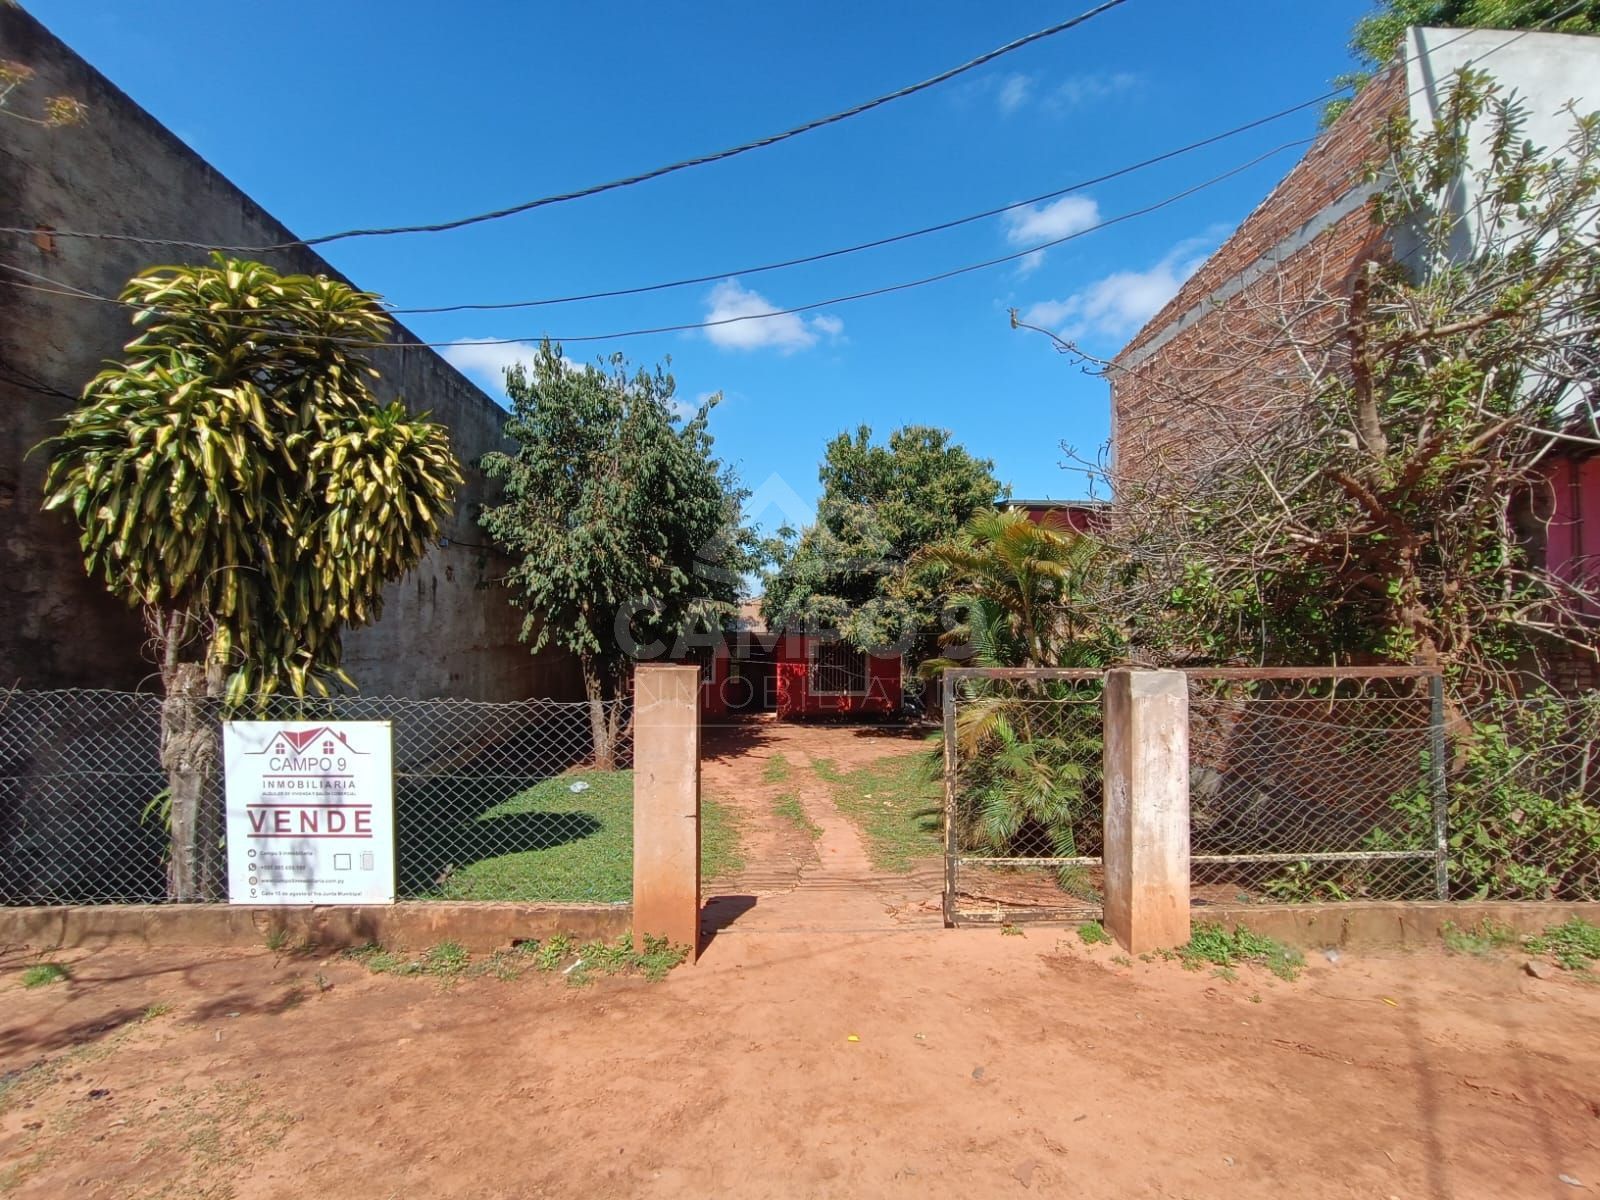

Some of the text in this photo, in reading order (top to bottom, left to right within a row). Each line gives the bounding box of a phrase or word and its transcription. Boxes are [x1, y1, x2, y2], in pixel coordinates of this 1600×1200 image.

[269, 757, 347, 772] CAMPO 9
[262, 780, 356, 789] INMOBILIARIA
[247, 810, 372, 833] VENDE
